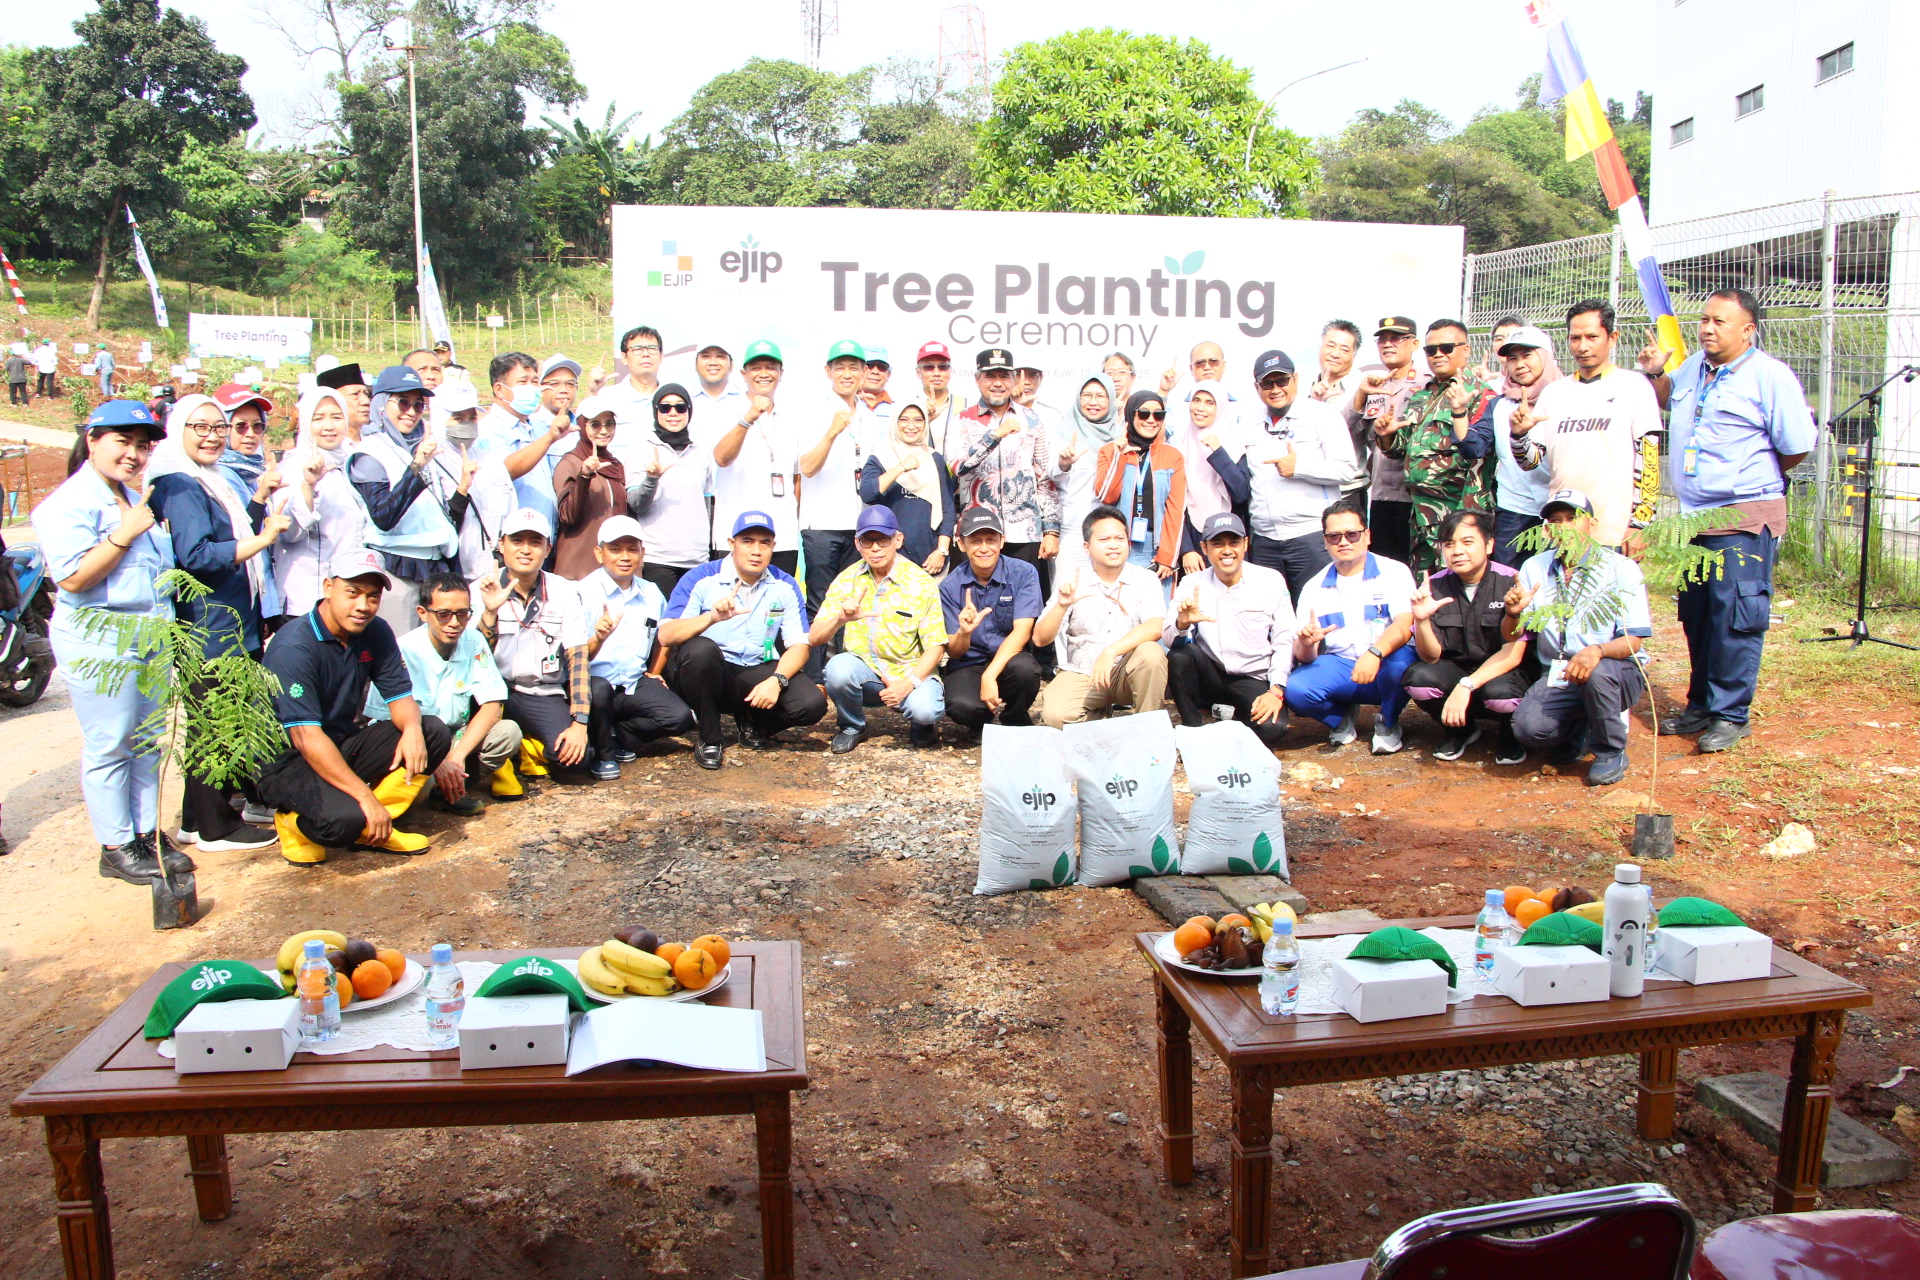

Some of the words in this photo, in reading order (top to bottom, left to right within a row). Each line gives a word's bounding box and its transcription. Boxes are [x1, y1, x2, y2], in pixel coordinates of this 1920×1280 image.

[719, 249, 783, 283] ejip
[664, 273, 693, 287] EJIP
[820, 261, 975, 313] Tree
[994, 260, 1276, 338] Planting
[214, 329, 239, 341] Tree
[241, 330, 288, 346] Planting
[947, 314, 1159, 358] Ceremony
[1105, 779, 1139, 799] ejip
[1217, 772, 1252, 789] ejip
[1022, 792, 1056, 811] ejip
[191, 968, 232, 991] ejip
[435, 1017, 444, 1025] Le
